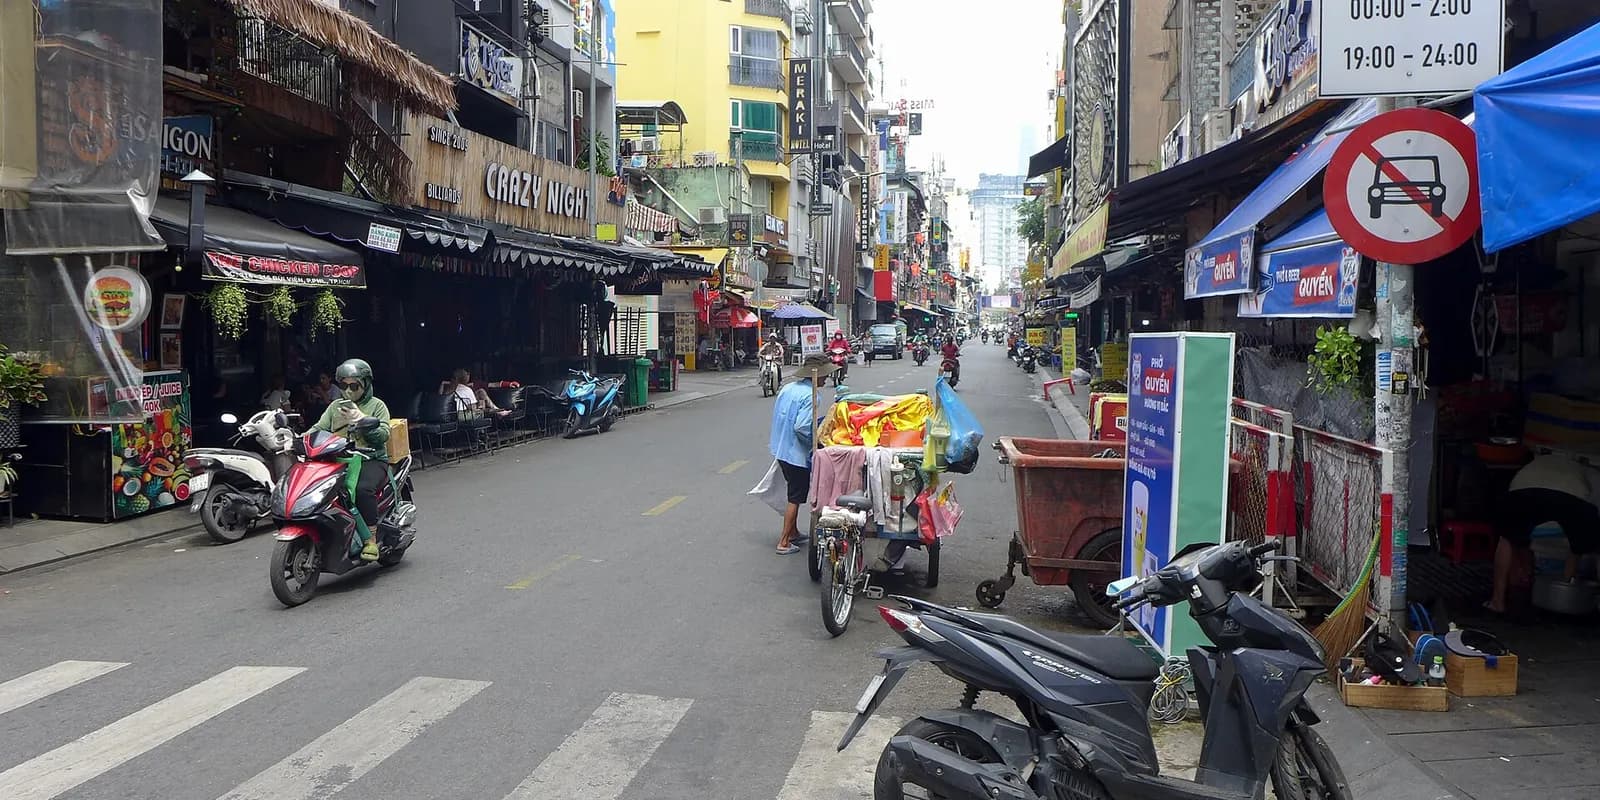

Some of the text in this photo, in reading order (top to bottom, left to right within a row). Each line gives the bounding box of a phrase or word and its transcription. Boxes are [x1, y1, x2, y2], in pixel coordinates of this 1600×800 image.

[1351, 0, 1404, 20] 00:00
[1430, 0, 1471, 17] 2:00
[1344, 45, 1395, 70] 19:00
[1422, 42, 1478, 67] 24:00
[794, 63, 807, 135] MERAKI
[133, 114, 212, 160] SAIGON
[430, 126, 451, 146] SINCE
[427, 183, 462, 205] BILLIARDS
[485, 162, 542, 209] CRAZY
[547, 180, 590, 221] NIGHT
[207, 250, 243, 269] THE
[248, 256, 320, 277] CHICKEN
[322, 264, 360, 279] COOP
[1288, 268, 1300, 282] BEER
[1151, 354, 1164, 369] PHỞ
[160, 382, 182, 396] JUICE
[143, 400, 160, 413] 40K
